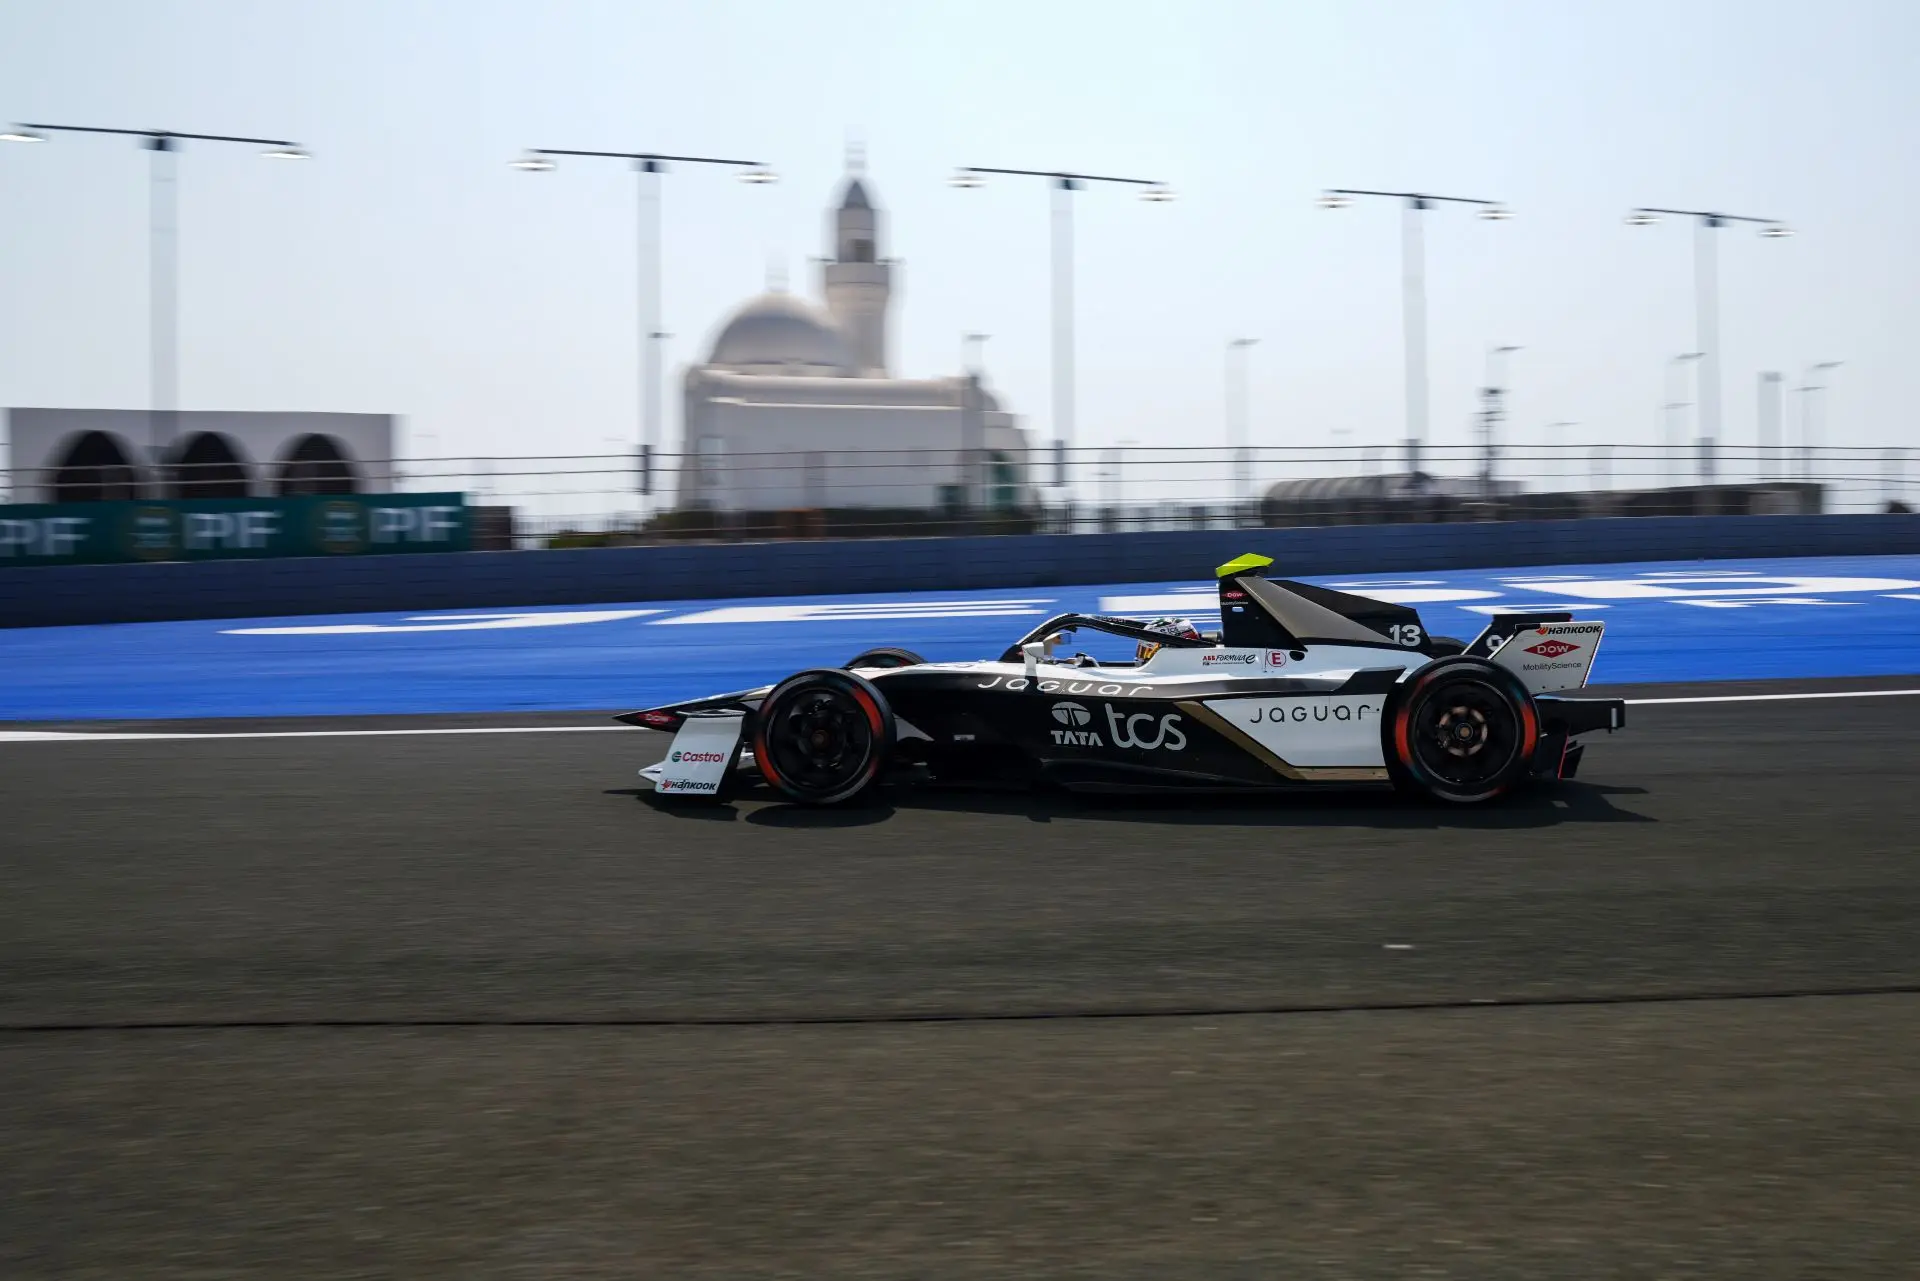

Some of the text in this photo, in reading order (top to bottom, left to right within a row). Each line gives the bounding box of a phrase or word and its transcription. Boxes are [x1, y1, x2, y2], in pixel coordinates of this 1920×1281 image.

[1389, 624, 1421, 647] 13
[1537, 645, 1569, 654] DOW
[1272, 652, 1282, 665] E
[1522, 662, 1582, 672] MobilityScience
[1104, 702, 1187, 750] tcs
[1050, 730, 1104, 747] TATA
[682, 751, 724, 763] Castrol
